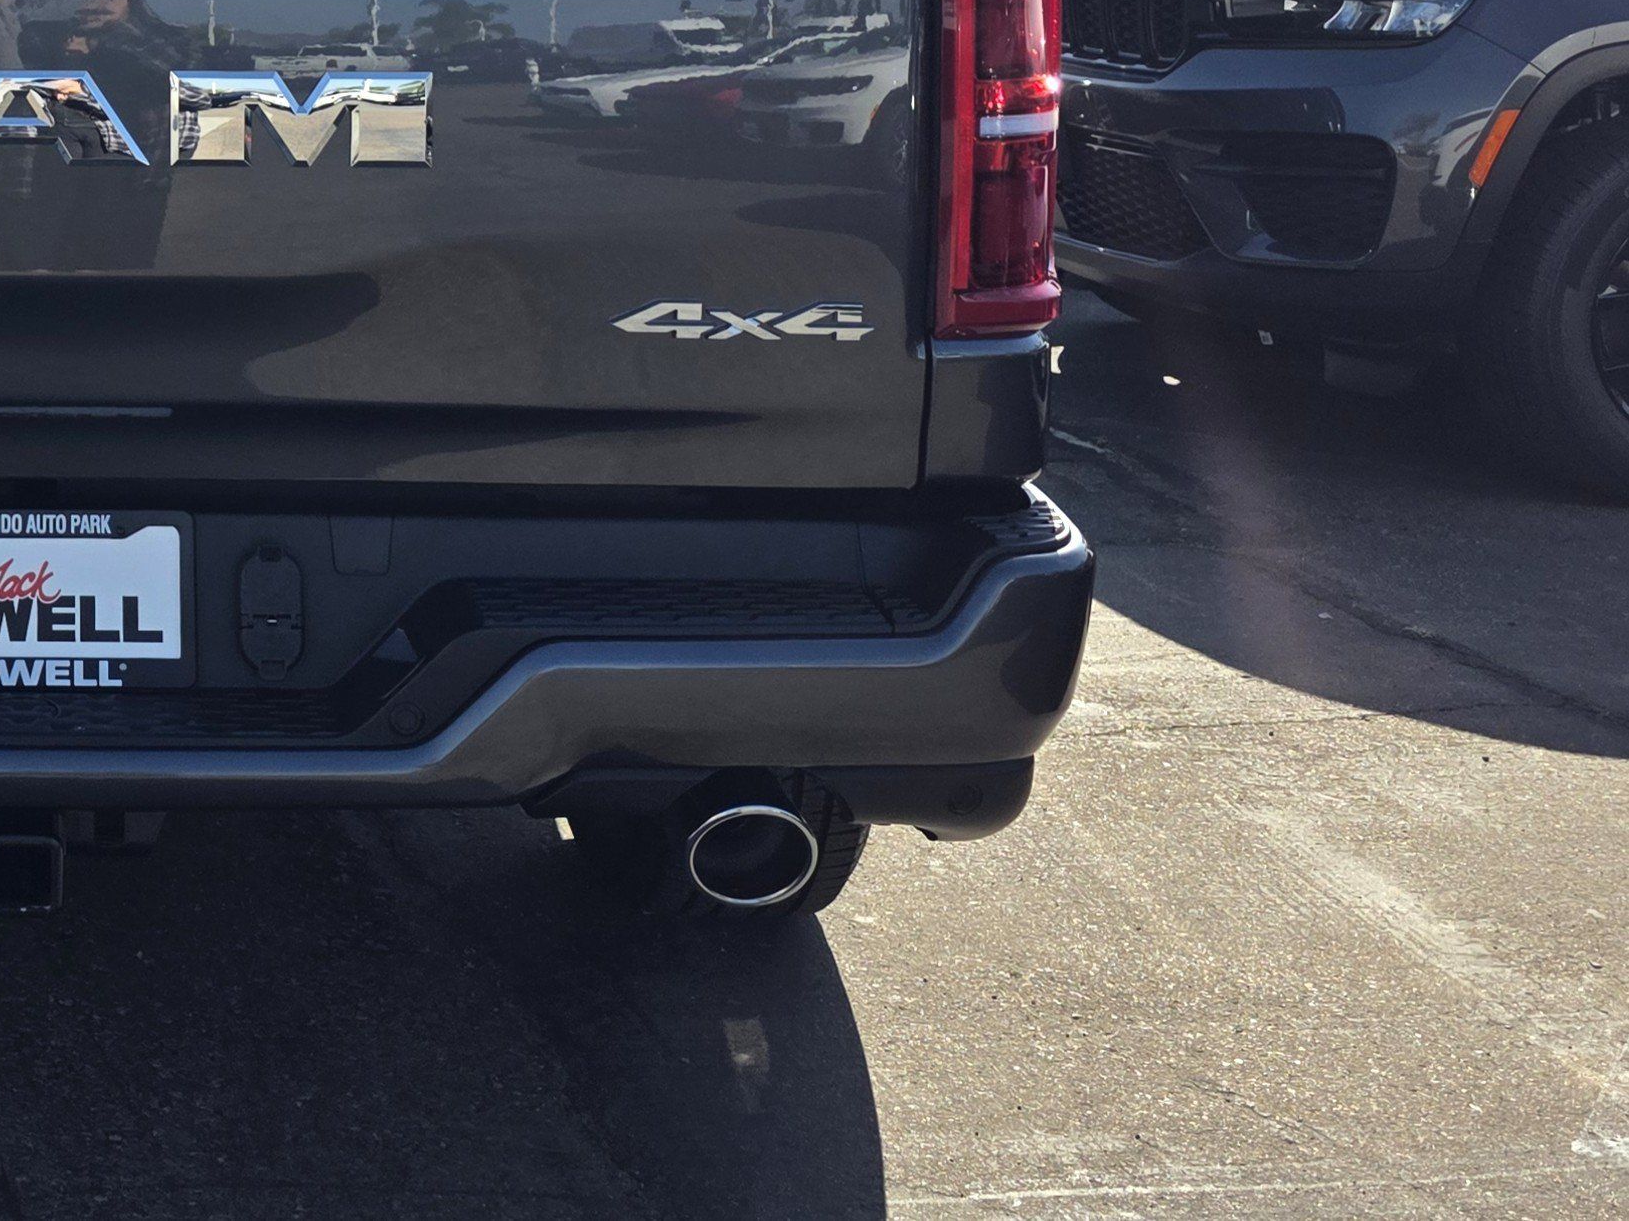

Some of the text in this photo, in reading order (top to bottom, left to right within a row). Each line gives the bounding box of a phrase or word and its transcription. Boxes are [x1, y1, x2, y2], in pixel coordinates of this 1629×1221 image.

[607, 297, 875, 342] 4x4
[25, 514, 67, 535] AUTO
[70, 514, 112, 535] PARK
